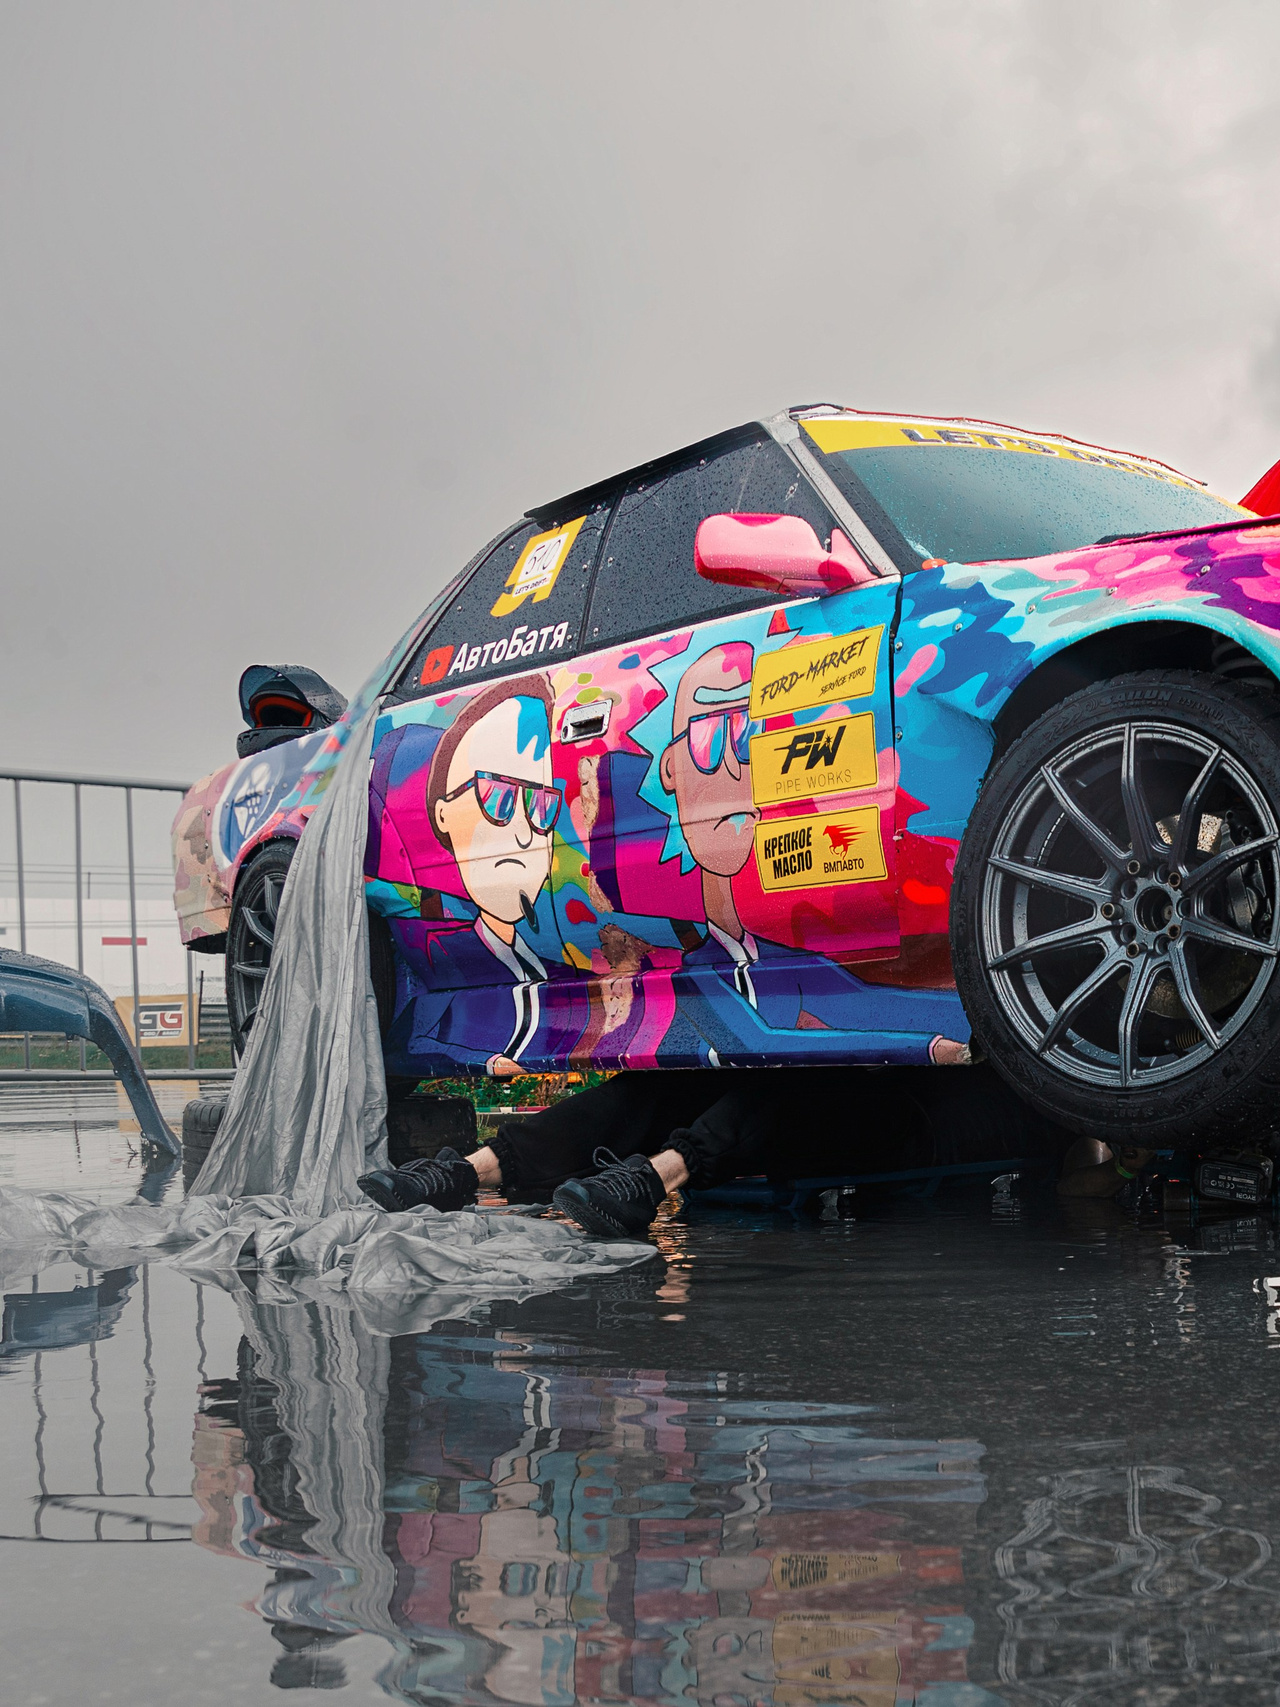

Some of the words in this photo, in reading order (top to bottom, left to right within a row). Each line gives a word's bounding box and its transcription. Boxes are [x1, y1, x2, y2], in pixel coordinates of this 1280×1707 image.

[448, 621, 569, 676] АвтоБатя
[760, 636, 871, 705] FORD-MARKET
[818, 676, 847, 697] SERVICE
[848, 666, 867, 684] FORD
[775, 779, 801, 794] PIPE
[806, 769, 852, 789] WORKS
[764, 826, 813, 860] КРЕПКОЕ
[772, 851, 813, 880] МАСЛО
[823, 858, 865, 873] ВМПАВТО
[1235, 1192, 1257, 1202] RYOBI
